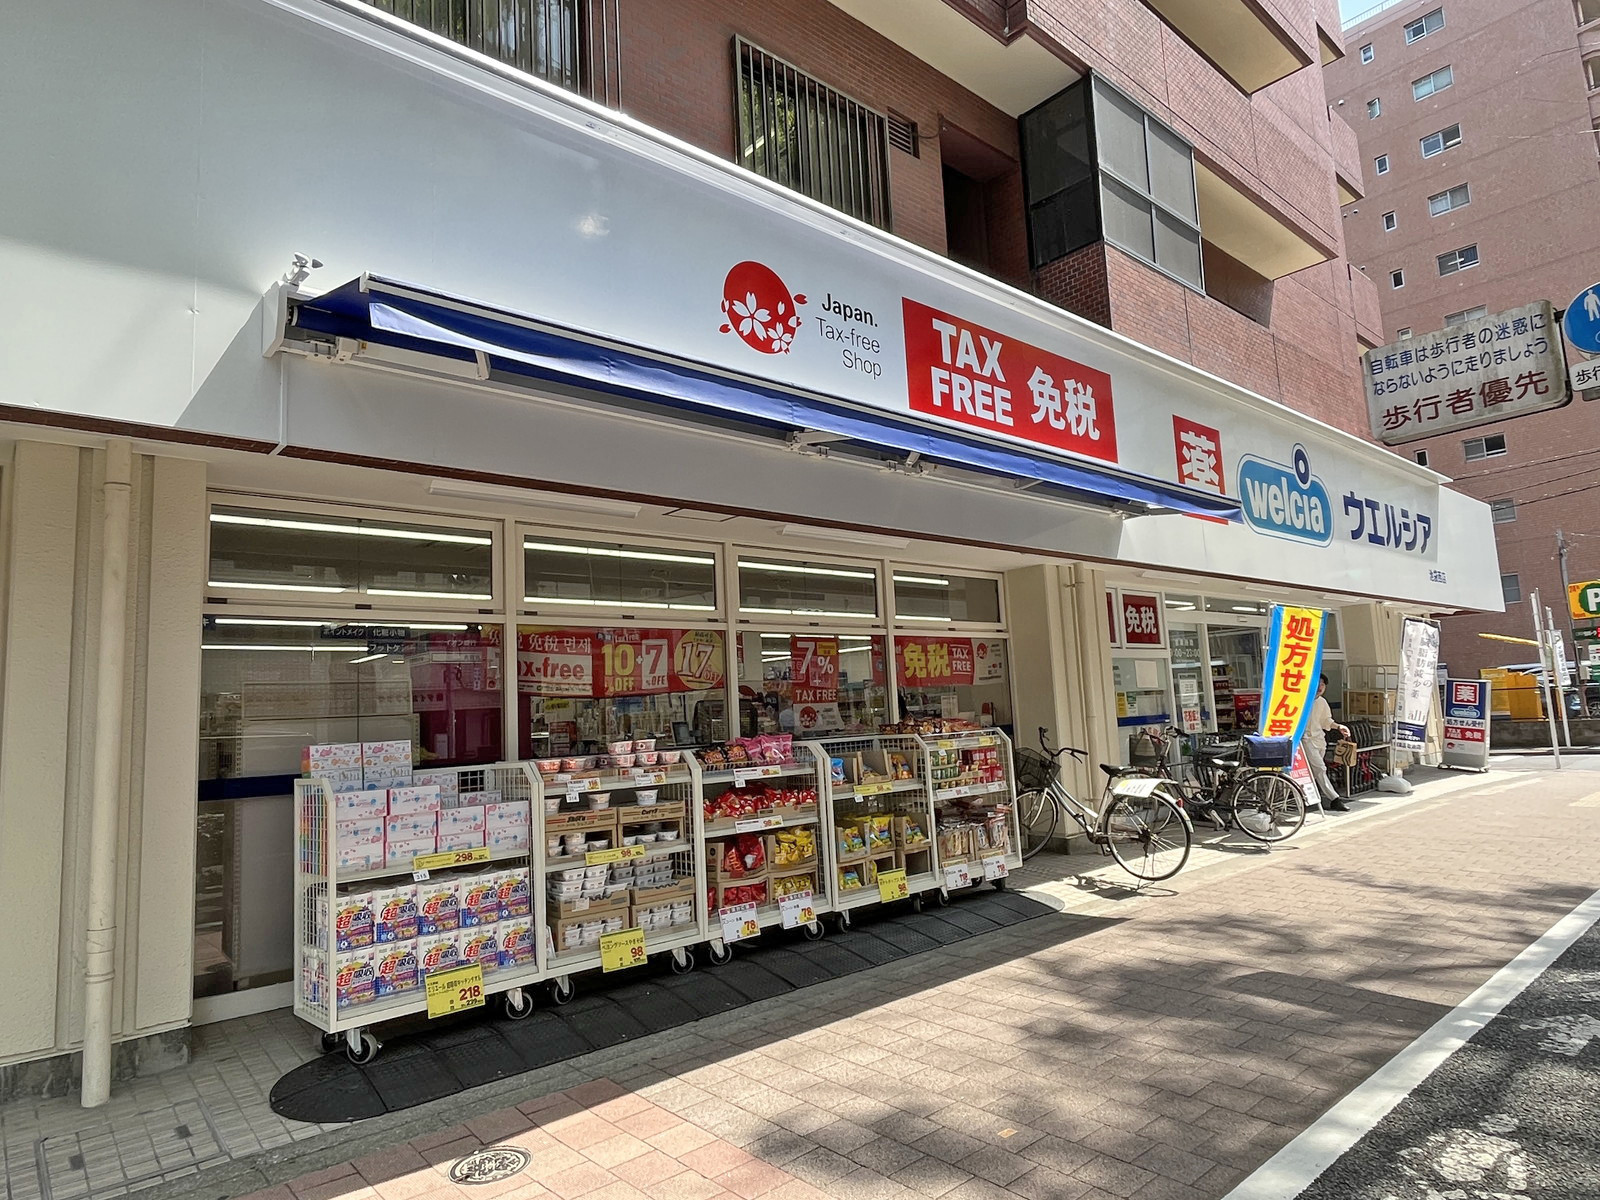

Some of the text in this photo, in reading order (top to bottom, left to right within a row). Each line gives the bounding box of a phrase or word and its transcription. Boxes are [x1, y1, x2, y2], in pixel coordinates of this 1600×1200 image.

[821, 293, 878, 327] Japan.
[815, 317, 880, 353] Tax-free
[932, 318, 1005, 382] TAX
[1371, 314, 1546, 375] 自転車は歩行者の迷惑に
[842, 349, 882, 380] Shop
[1373, 337, 1548, 395] ならないように走りましょう
[931, 366, 1013, 427] FREE
[1027, 366, 1101, 441] 免税
[1383, 370, 1549, 431] 歩行者優先
[1180, 431, 1219, 489] 薬
[1245, 476, 1324, 533] welcia
[1343, 491, 1431, 554] ウエルシア
[1126, 605, 1157, 634] 免税
[601, 644, 635, 676] 10
[645, 645, 663, 675] 7
[677, 643, 715, 678] 17
[904, 643, 951, 678] 免税
[952, 648, 968, 659] TAX
[952, 660, 972, 672] FREE
[796, 689, 837, 701] TAX FREE
[455, 853, 473, 863] 298
[744, 920, 756, 930] 78
[802, 907, 813, 917] 78
[631, 946, 644, 958] 98
[459, 985, 481, 1001] 218
